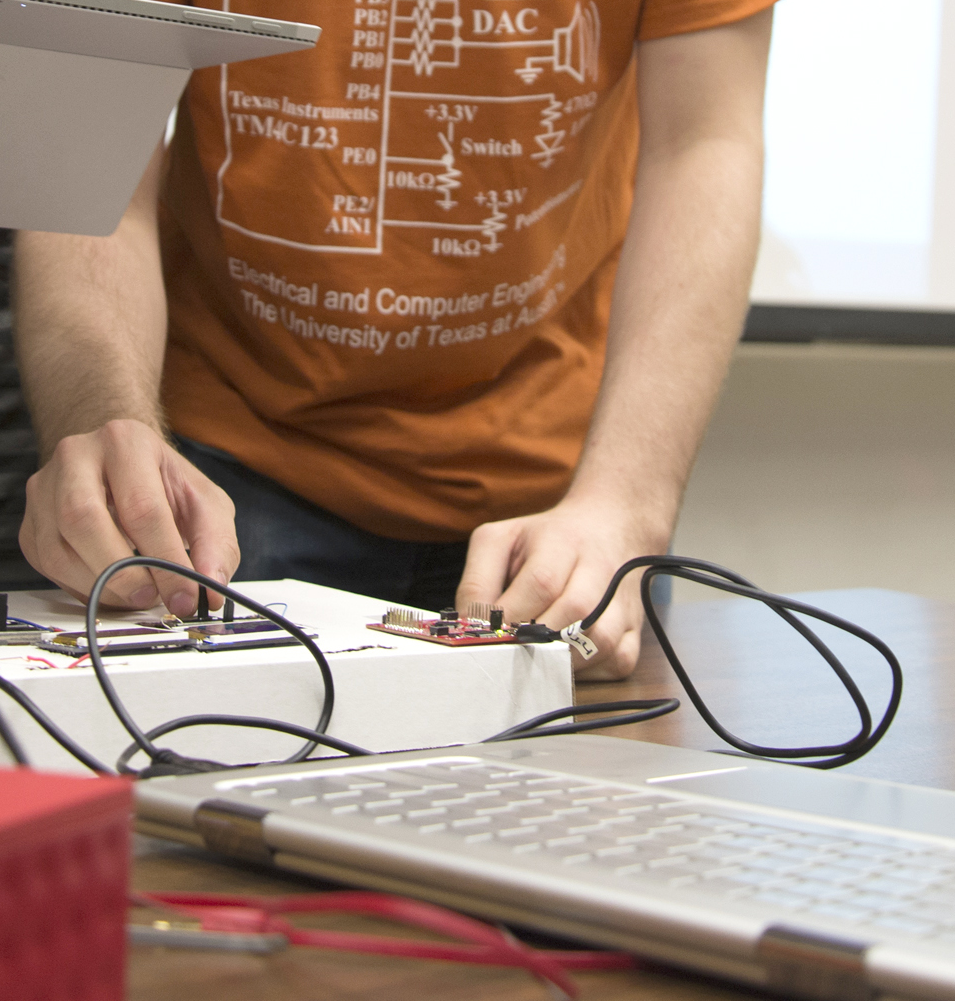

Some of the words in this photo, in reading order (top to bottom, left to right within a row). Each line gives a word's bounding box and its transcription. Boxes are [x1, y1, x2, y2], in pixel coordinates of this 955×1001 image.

[354, 8, 388, 26] PB2
[472, 9, 539, 35] DAC
[352, 29, 385, 48] PB1
[350, 51, 384, 69] PB0
[346, 82, 380, 100] PB4
[229, 90, 280, 110] Texas
[281, 96, 379, 122] Instruments
[424, 103, 478, 122] +3.3V
[230, 113, 339, 150] TM4C123
[342, 146, 377, 165] PE0
[460, 137, 523, 156] Switch
[386, 170, 436, 190] 10kΩ
[332, 194, 375, 213] PE2/
[325, 216, 371, 236] AIN1
[228, 256, 318, 307] Electrical
[324, 287, 370, 314] and
[376, 287, 489, 321] Computer
[241, 289, 278, 323] The
[280, 306, 391, 355] University
[396, 325, 421, 350] of
[426, 321, 487, 347] Texas
[491, 312, 512, 336] at
